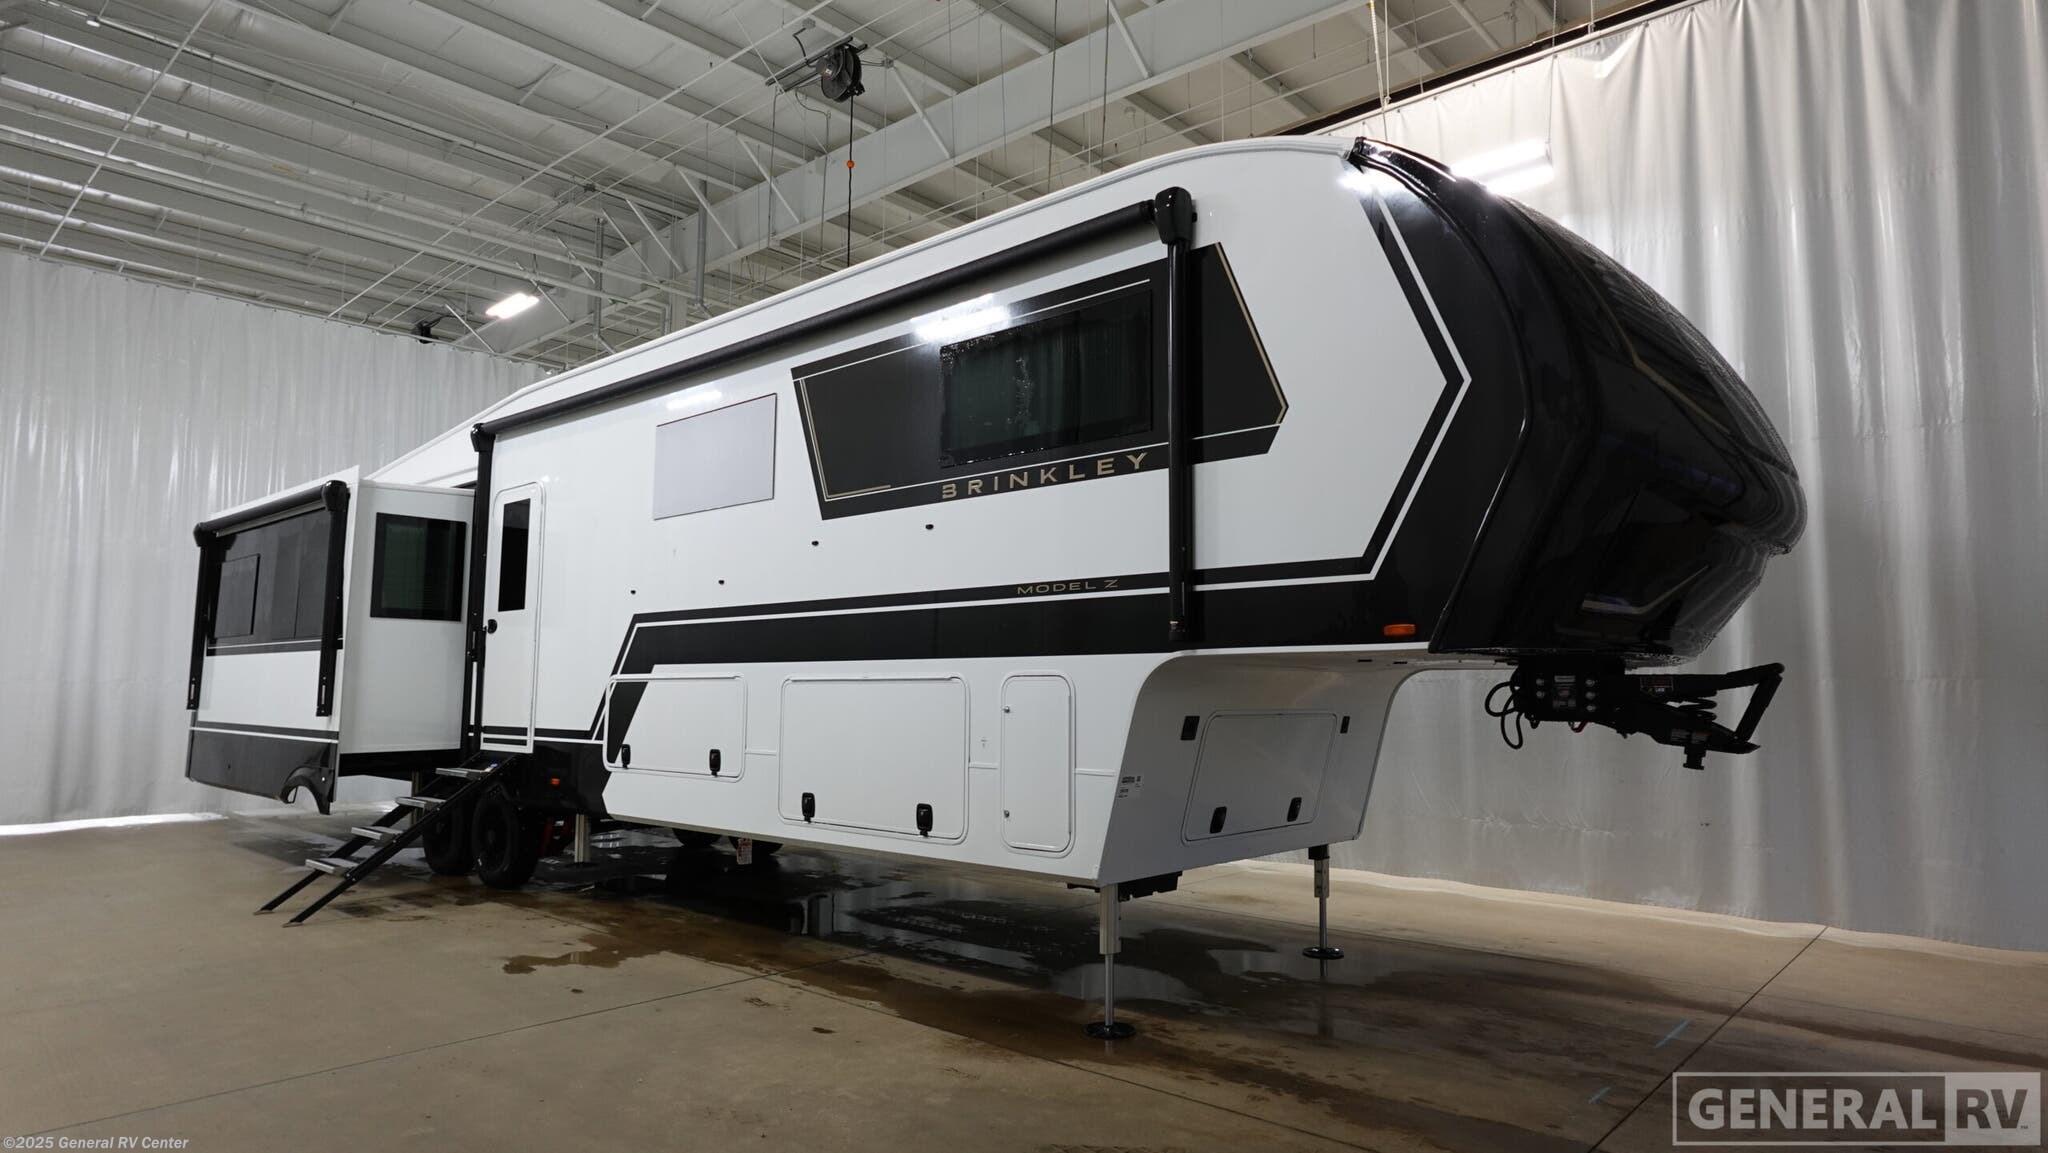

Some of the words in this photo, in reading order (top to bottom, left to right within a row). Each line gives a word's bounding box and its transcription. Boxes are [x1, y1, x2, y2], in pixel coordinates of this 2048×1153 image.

[942, 452, 1148, 499] BRINKLEY
[1017, 581, 1096, 595] MODEL
[1103, 579, 1119, 588] Z
